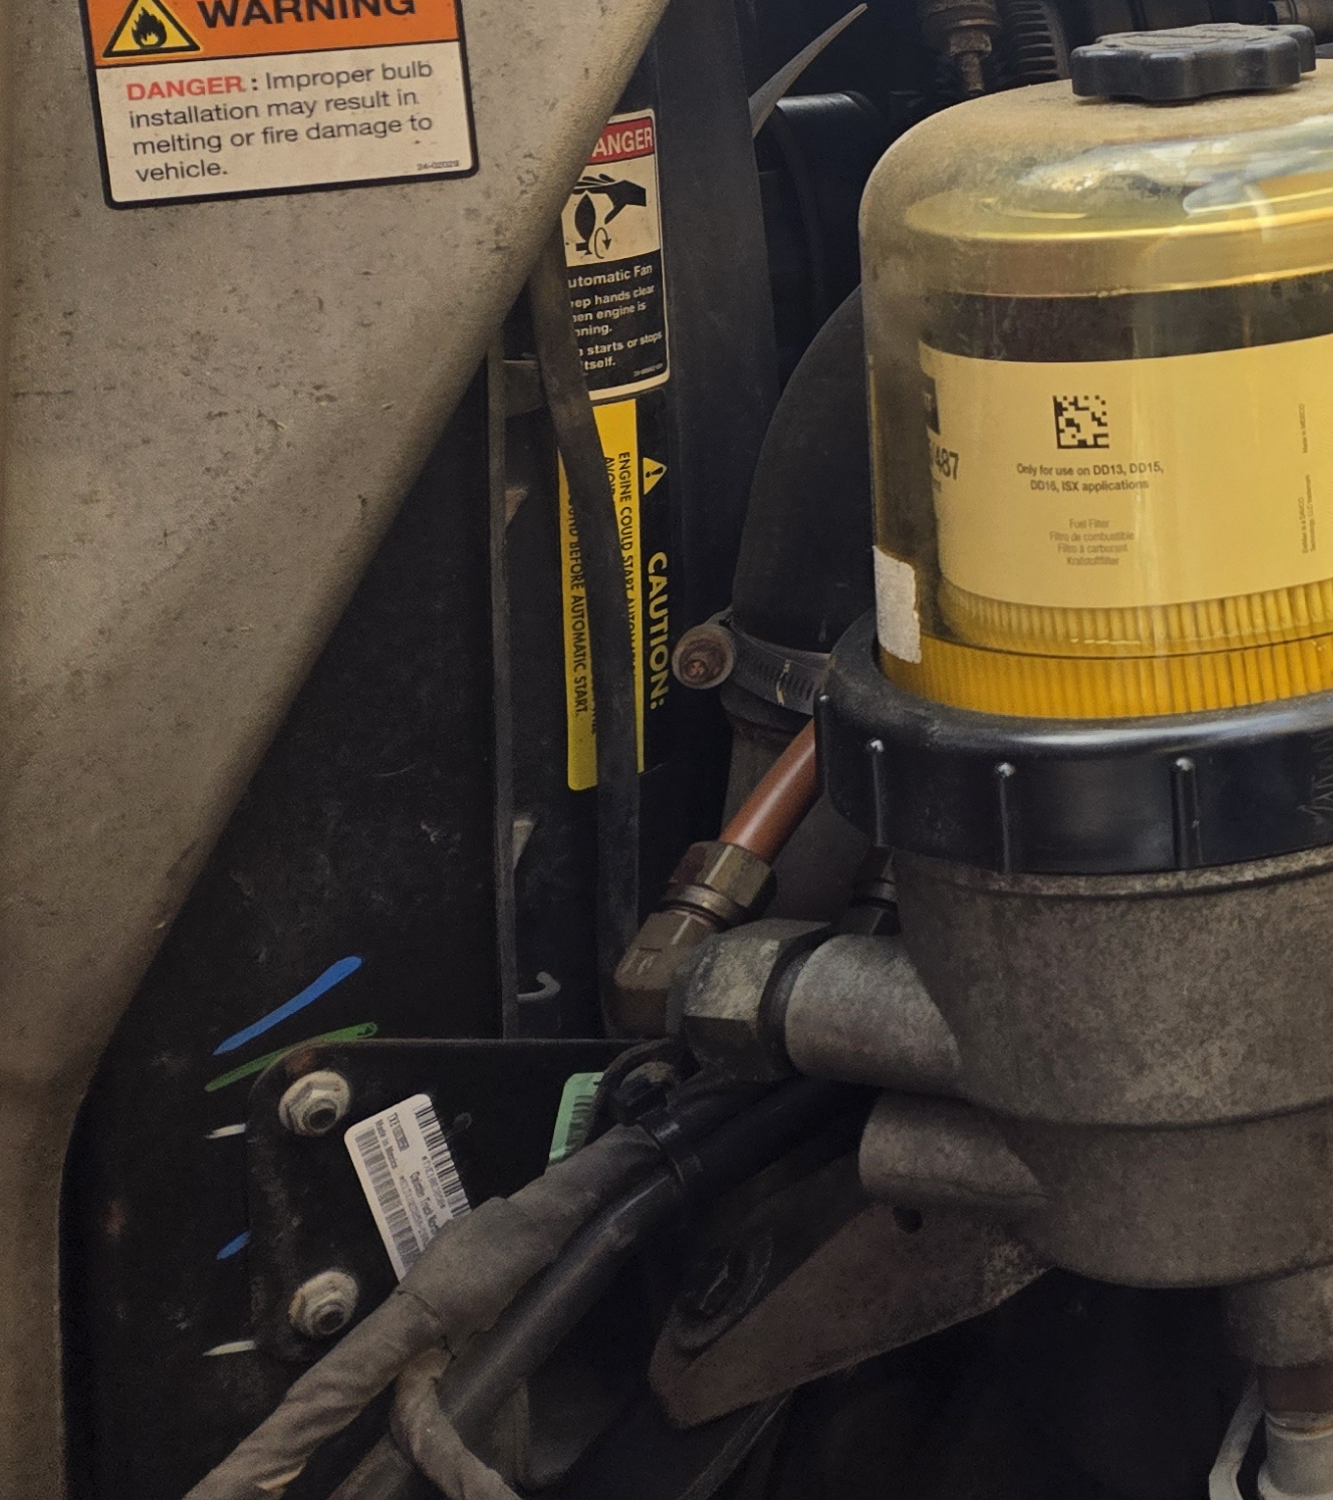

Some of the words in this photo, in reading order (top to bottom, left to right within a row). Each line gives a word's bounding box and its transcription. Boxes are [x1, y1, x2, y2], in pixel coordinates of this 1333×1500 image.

[126, 75, 243, 101] DANGER
[266, 65, 376, 91] Improper
[381, 60, 433, 81] bulb
[129, 102, 260, 129] installation
[267, 96, 318, 119] may
[325, 89, 391, 113] result
[397, 89, 418, 107] in
[133, 128, 223, 157] melting
[230, 130, 254, 148] or
[262, 124, 299, 146] fire
[305, 116, 402, 143] damage
[410, 114, 433, 133] to
[592, 127, 653, 158] ANGER
[135, 160, 229, 183] vehicle.
[568, 268, 632, 290] utomatic
[633, 263, 653, 278] Fan
[570, 296, 591, 310] ep
[594, 291, 630, 306] hands
[633, 285, 655, 299] clear
[573, 309, 593, 322] en
[596, 304, 635, 321] engine
[637, 301, 647, 312] is
[575, 326, 613, 341] ning.
[587, 341, 624, 356] starts
[627, 339, 639, 350] or
[640, 332, 663, 349] stops
[582, 358, 616, 371] tself.
[932, 442, 959, 481] 487
[1016, 462, 1037, 477] Only
[1039, 463, 1053, 476] for
[1055, 466, 1074, 476] use
[1077, 467, 1090, 476] on
[1093, 463, 1126, 477] DD13,
[1129, 461, 1164, 476] DD15,
[618, 451, 632, 503] ENGINE
[1030, 479, 1059, 493] DD16,
[1061, 480, 1079, 492] ISX
[1082, 479, 1149, 494] applications
[619, 506, 634, 551] COULD
[1069, 518, 1087, 529] Fuel
[1088, 518, 1110, 529] Filter
[1071, 531, 1081, 541] de
[1083, 531, 1135, 542] combustible
[571, 595, 587, 677] AUTOMATIC
[647, 551, 671, 710] CAUTION:
[573, 678, 588, 715] START.
